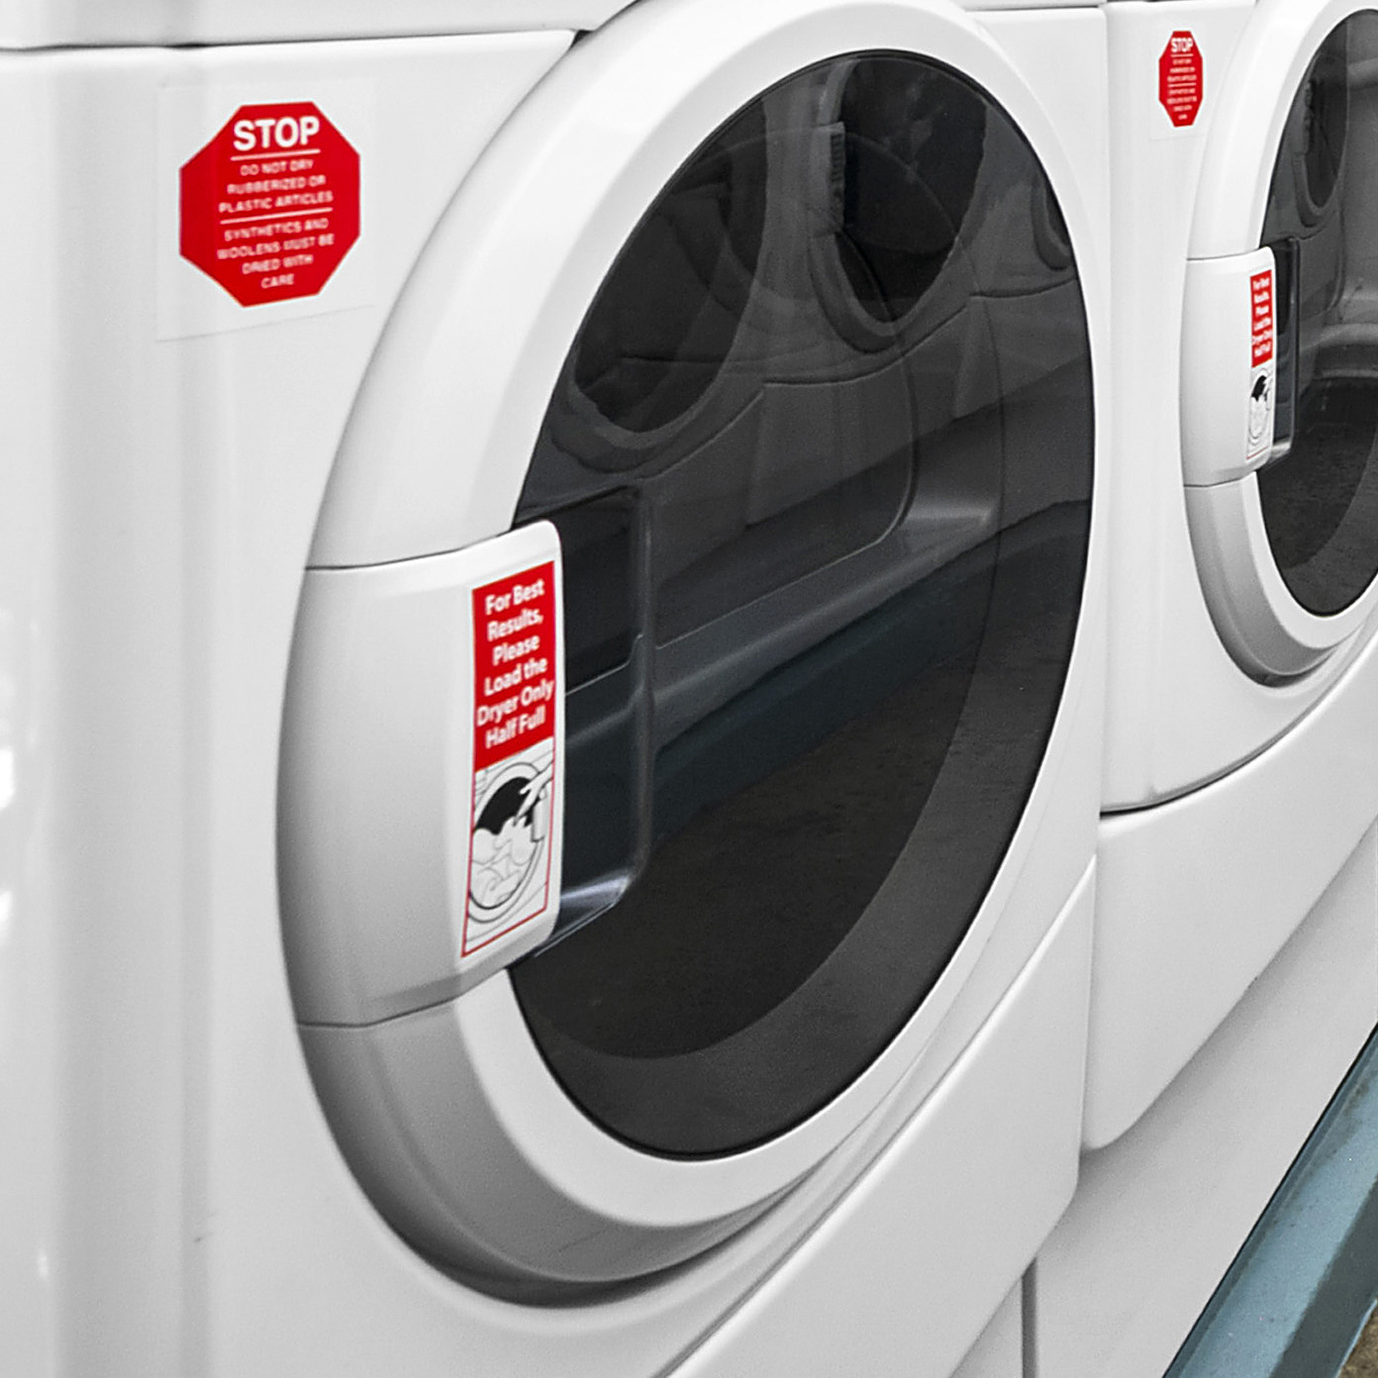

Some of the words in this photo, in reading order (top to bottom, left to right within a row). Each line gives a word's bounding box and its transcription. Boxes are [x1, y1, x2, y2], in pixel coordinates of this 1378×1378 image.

[1171, 37, 1193, 53] STOP
[233, 115, 320, 151] STOP
[240, 164, 259, 176] DO
[262, 161, 287, 174] NOT
[289, 159, 314, 172] DRY
[227, 177, 306, 195] RUBBERIZED
[308, 174, 326, 186] OR
[218, 196, 273, 213] PLASTIC
[274, 190, 334, 208] ARTICLES
[224, 221, 302, 242] SYNTHETICS
[304, 218, 329, 231] AND
[217, 241, 281, 260] WOOLENS
[283, 235, 316, 251] MUST
[318, 233, 335, 246] BE
[241, 258, 281, 275] DRIED
[282, 254, 314, 268] WITH
[260, 273, 295, 289] CARE
[485, 590, 513, 616] For
[513, 578, 545, 605] Best
[487, 607, 544, 642] Results,
[493, 634, 540, 666] Please
[484, 666, 522, 696] Load
[523, 656, 548, 681] the
[477, 696, 519, 727] Dryer
[520, 678, 554, 708] Only
[485, 721, 517, 749] Half
[518, 704, 546, 732] Full
